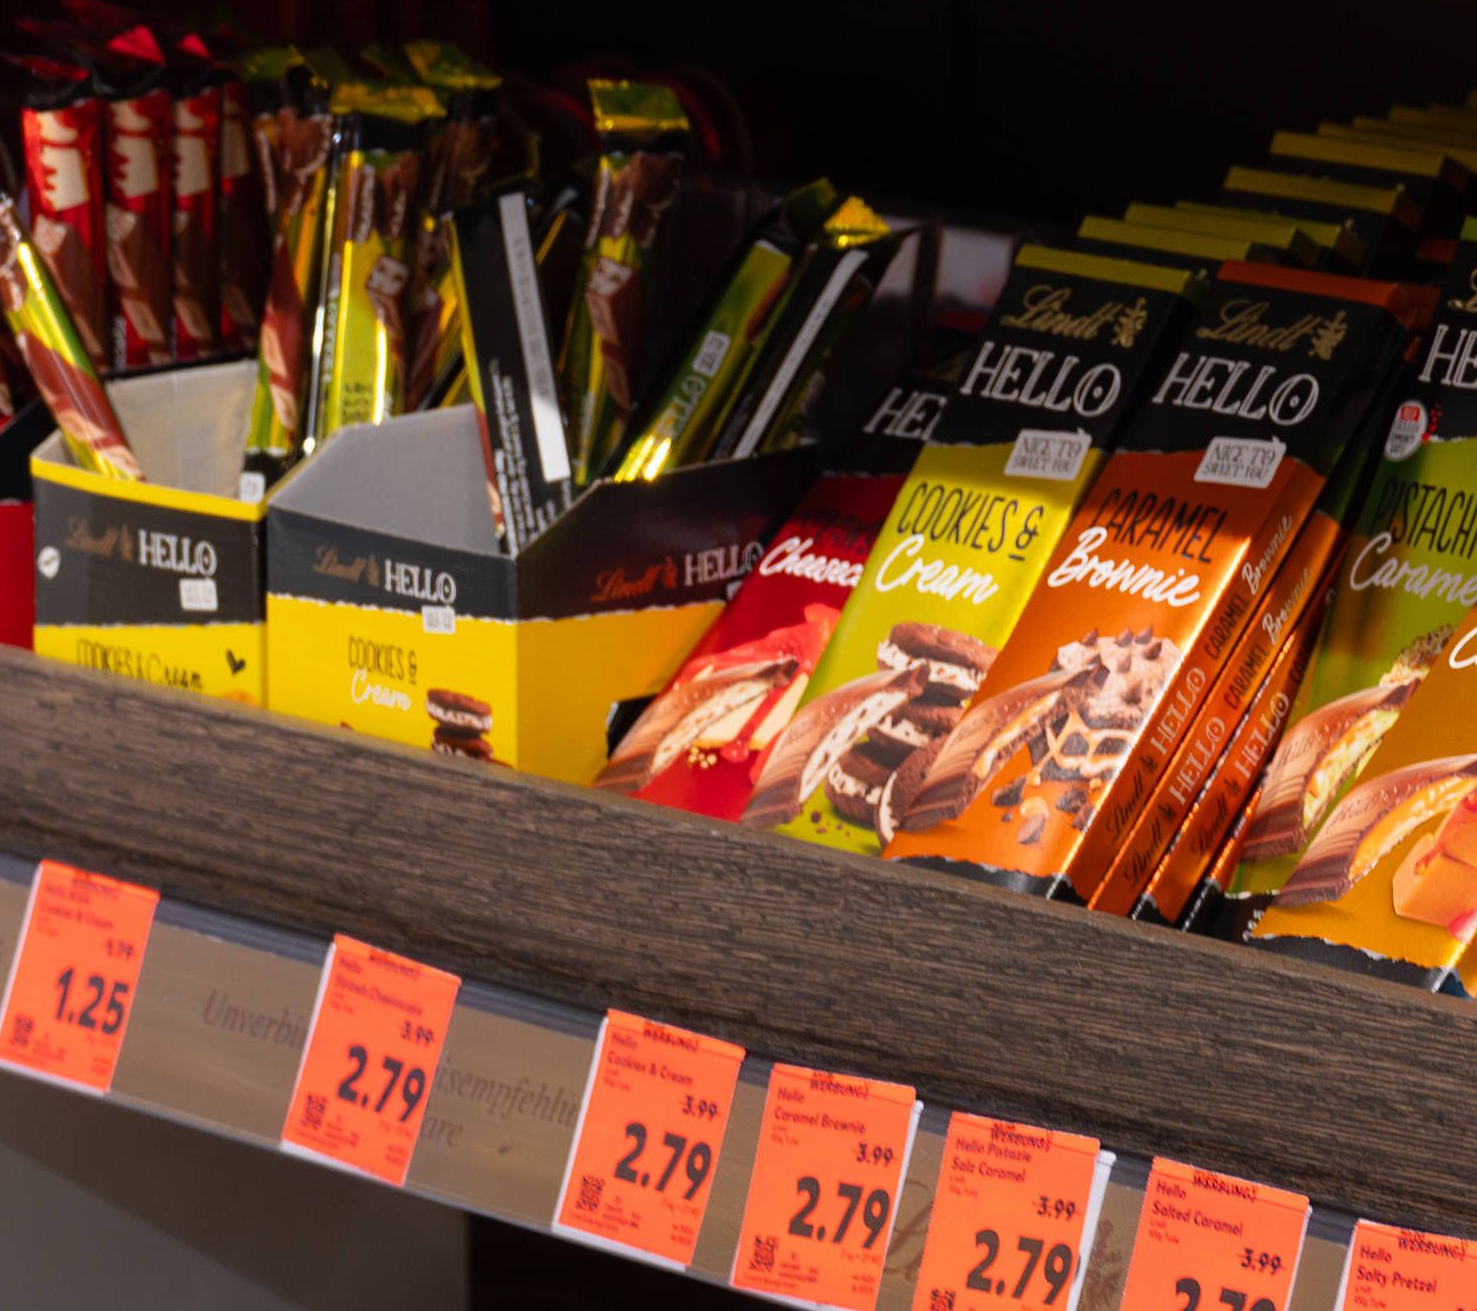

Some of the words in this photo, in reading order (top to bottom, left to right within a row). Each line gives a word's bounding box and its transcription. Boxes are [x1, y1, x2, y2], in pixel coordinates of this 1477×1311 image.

[960, 340, 1123, 420] HELLO
[1151, 350, 1321, 427] HELLO
[895, 481, 1003, 554] COOKIES
[1088, 487, 1229, 565] CARAMEL
[875, 534, 1001, 610] Cream
[1048, 523, 1202, 610] Brownie
[348, 636, 404, 682] COOKIES
[53, 967, 131, 1037] 1.25
[614, 1121, 713, 1201] 2.79
[788, 1175, 892, 1250] 2.79
[1151, 1199, 1190, 1223] Salted
[1193, 1208, 1243, 1238] Caramel
[966, 1228, 1076, 1306] 2.79
